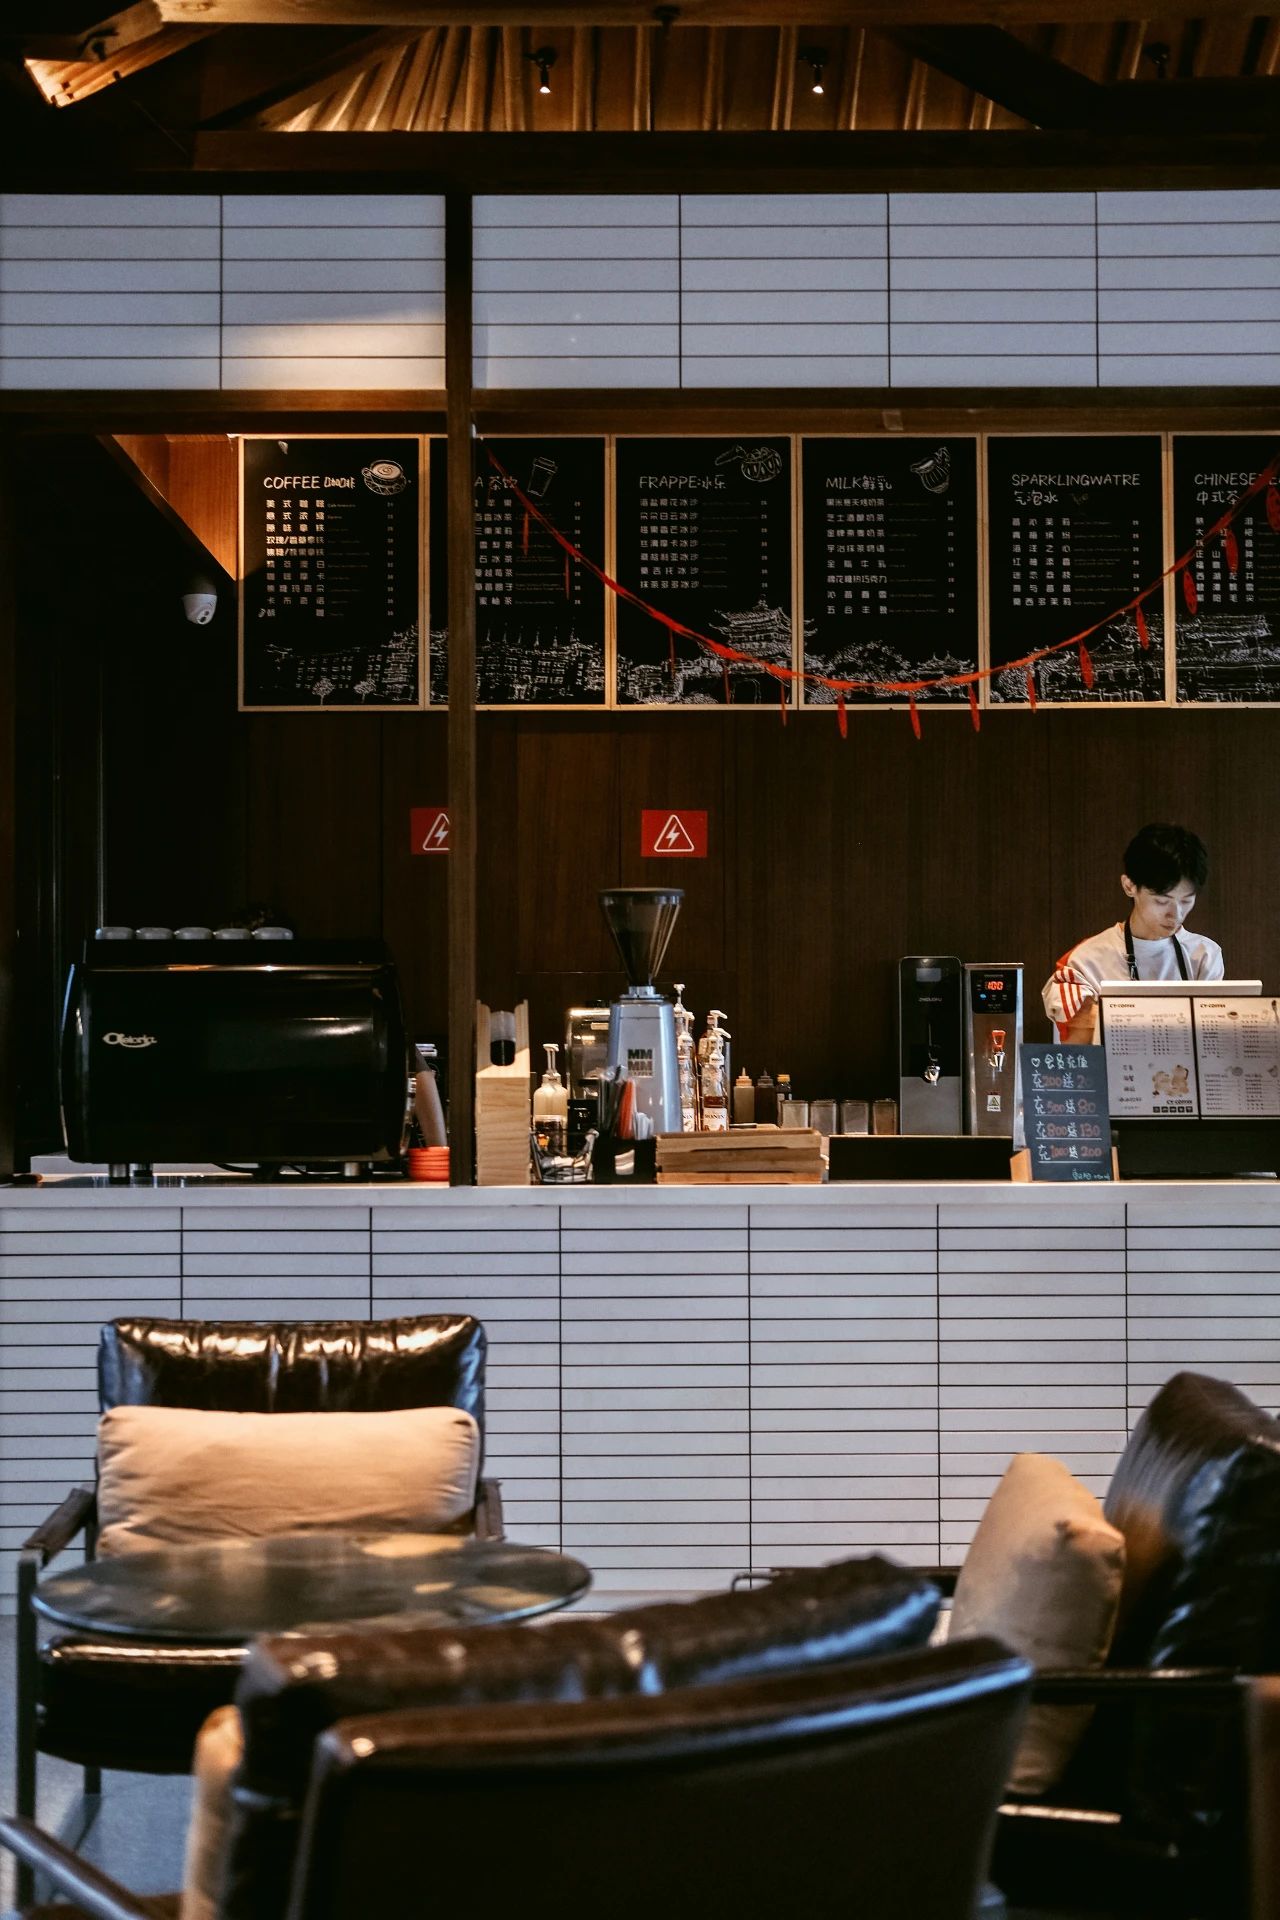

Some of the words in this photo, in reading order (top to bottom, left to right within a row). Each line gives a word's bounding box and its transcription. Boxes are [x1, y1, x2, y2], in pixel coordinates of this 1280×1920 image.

[263, 476, 321, 490] COFFEE
[1011, 473, 1141, 487] SPARKLINGWATRE
[1194, 473, 1257, 486] CHINESE
[1195, 490, 1241, 506] 中式茶
